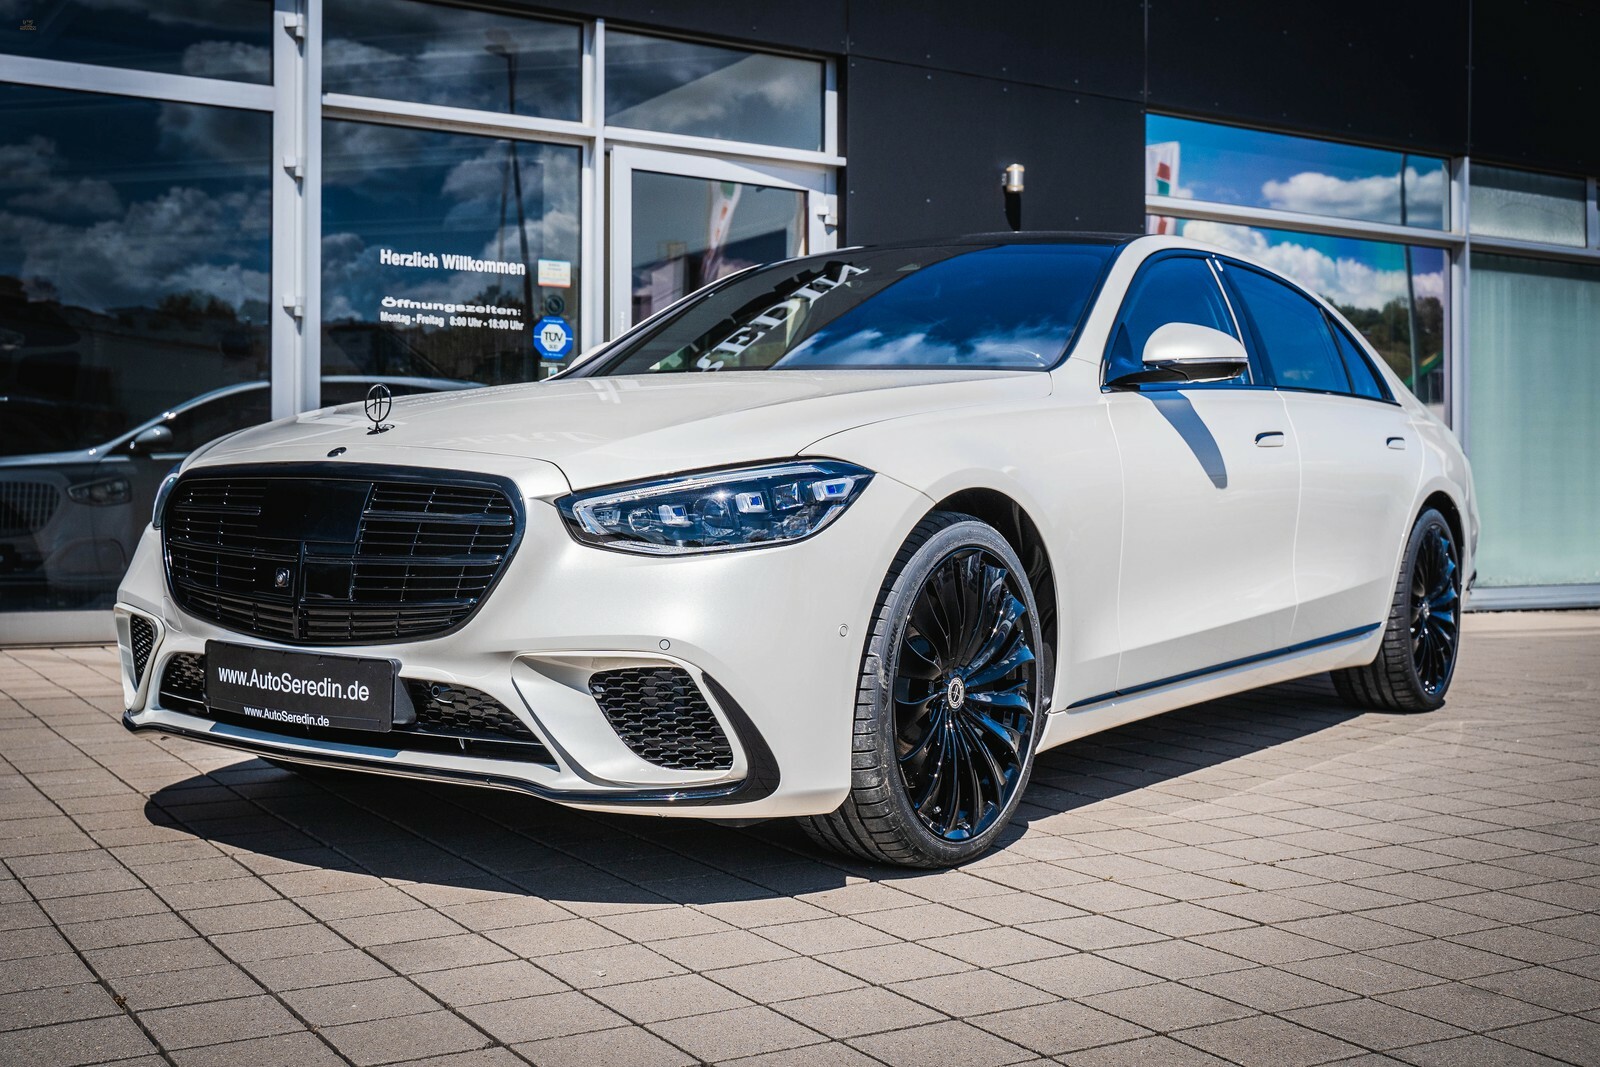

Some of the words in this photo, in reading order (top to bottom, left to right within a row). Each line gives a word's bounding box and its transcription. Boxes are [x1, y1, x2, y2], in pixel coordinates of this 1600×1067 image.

[380, 248, 438, 269] Herzlich
[441, 253, 526, 276] Willkommen
[381, 296, 522, 317] Öffnungszeiten:
[380, 311, 411, 326] Montag
[416, 313, 445, 328] Freitag
[467, 317, 483, 328] Uhr
[509, 320, 524, 331] Uhr
[218, 666, 370, 702] www.AutoSeredin.de
[243, 705, 330, 727] www.AutoSeredin.de
